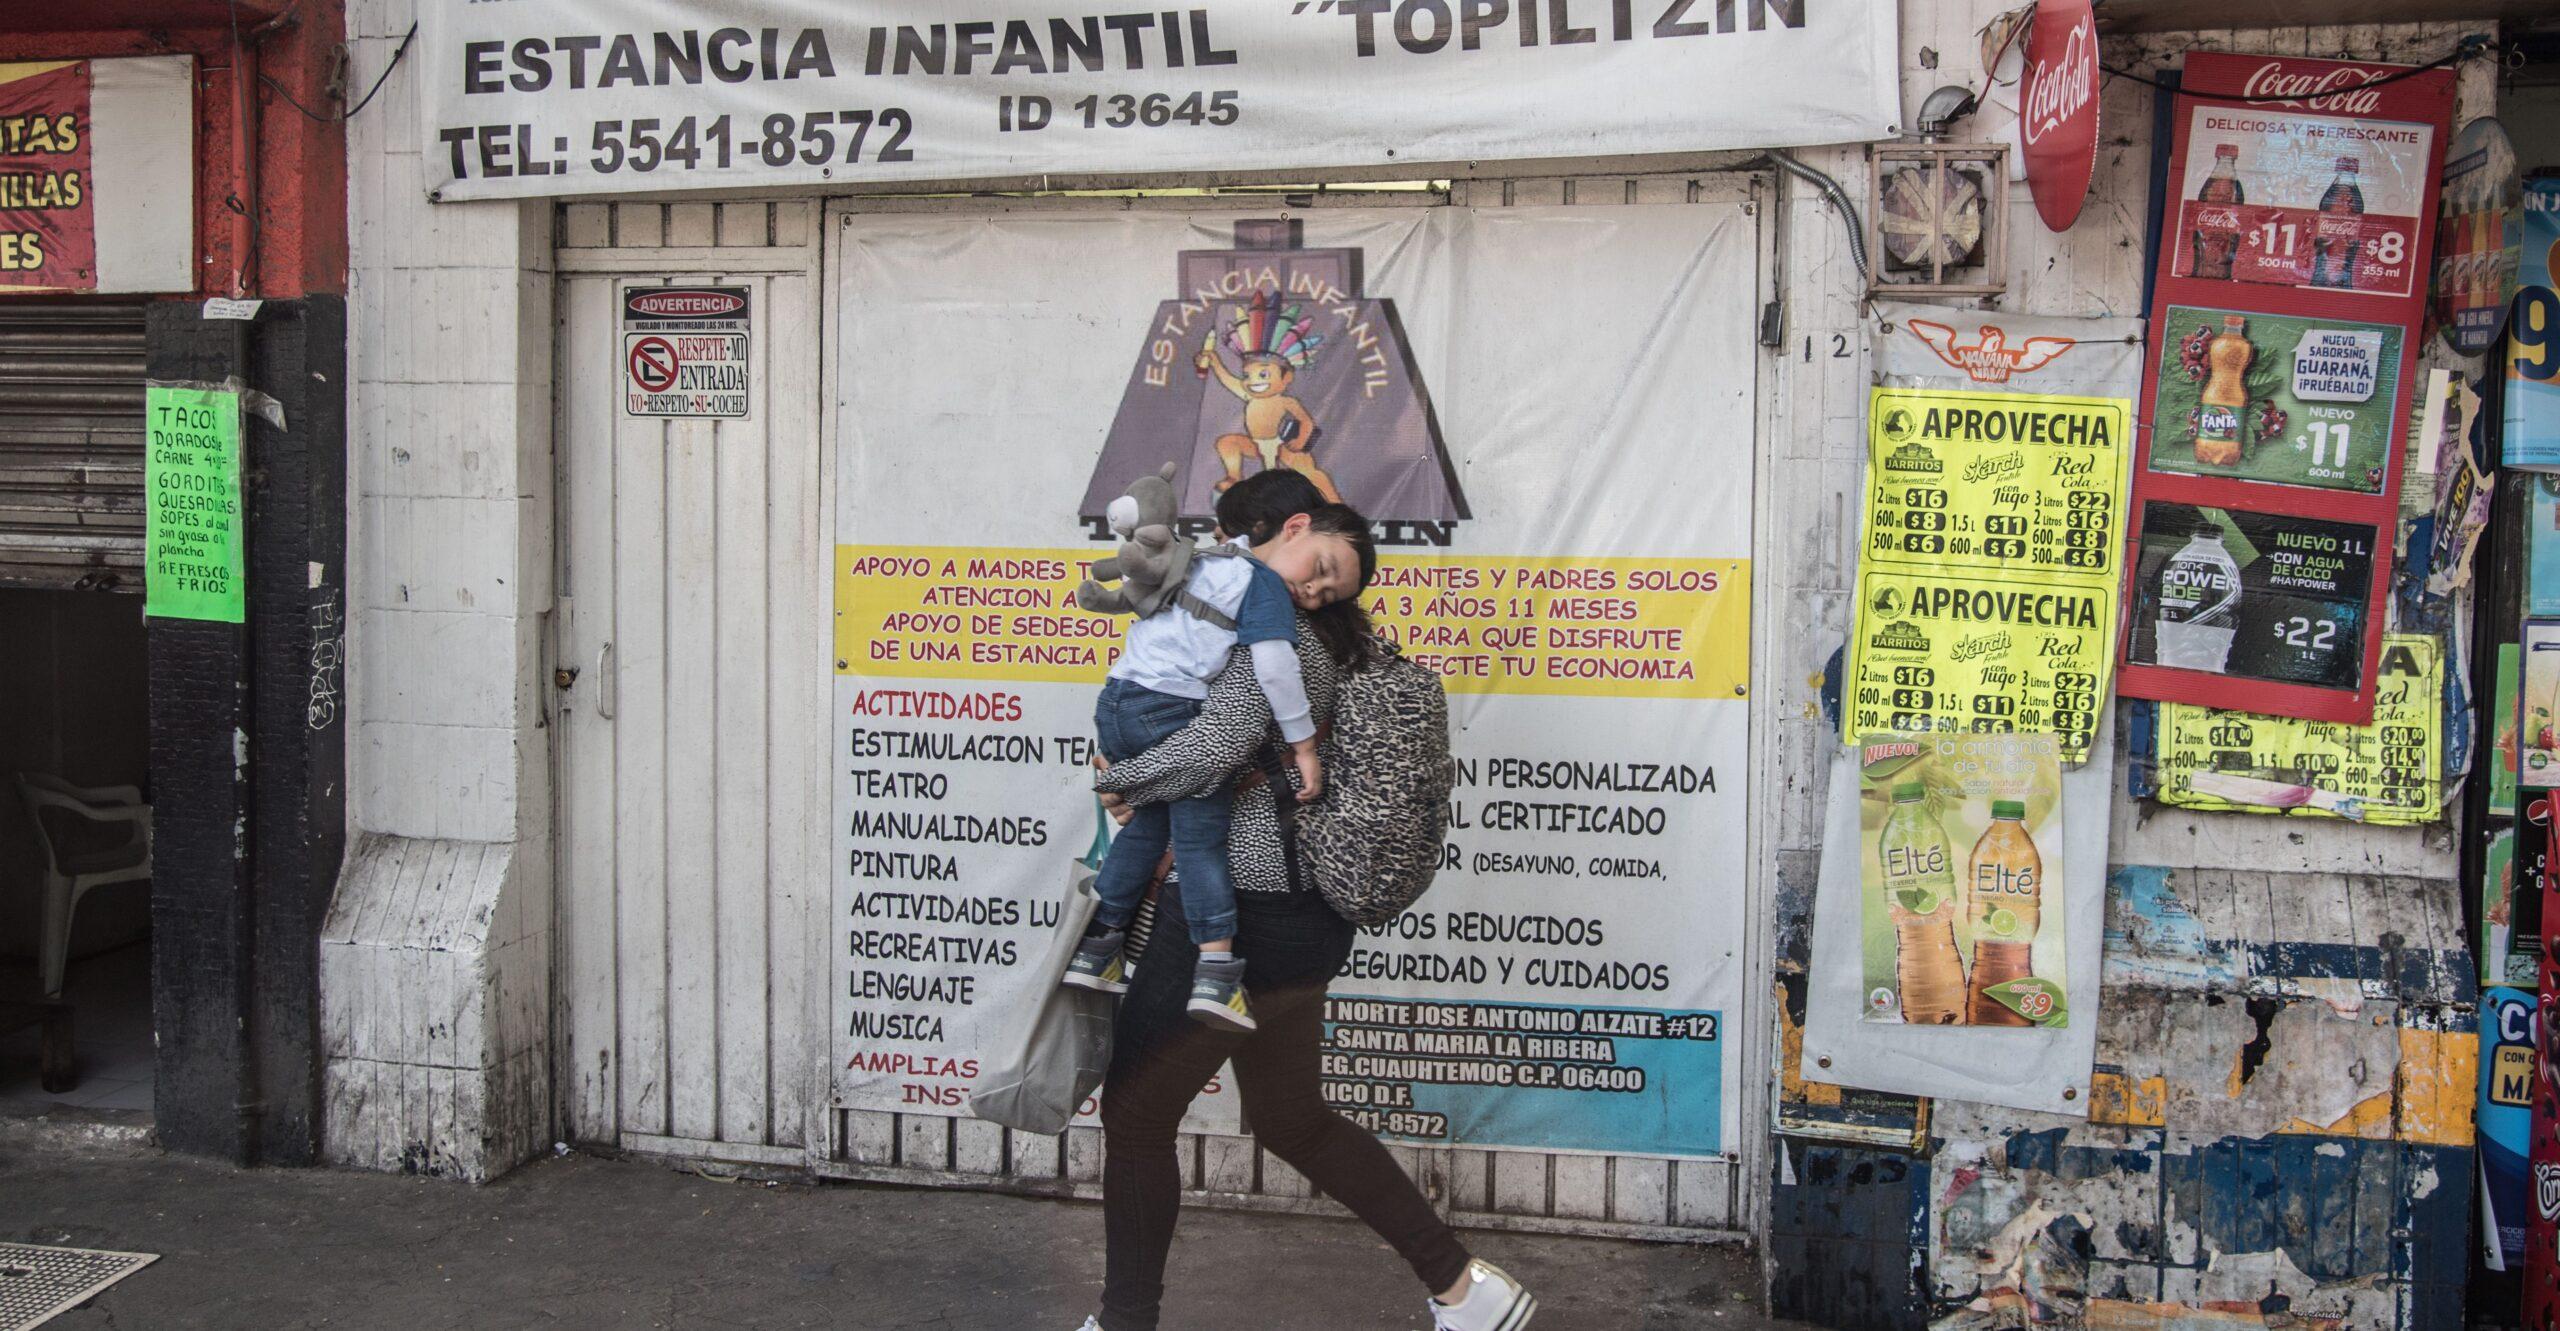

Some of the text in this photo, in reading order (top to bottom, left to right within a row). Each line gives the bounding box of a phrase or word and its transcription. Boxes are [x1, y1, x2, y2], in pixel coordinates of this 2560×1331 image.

[464, 9, 1238, 95] ESTANCIA INFANTIL
[2025, 14, 2091, 145] Coca-Cola
[2243, 62, 2391, 114] Coca-Cola
[1000, 90, 1240, 132] ID 13645
[0, 115, 78, 152] TAS
[2206, 117, 2419, 144] DELICIOSA REFRESCANTE
[440, 108, 913, 180] TEL: 5541-8572
[2248, 221, 2297, 257] $11
[2366, 231, 2405, 265] $8
[2257, 256, 2280, 269] 500
[640, 298, 734, 312] ADVERTENCIA
[636, 322, 660, 330] VIGILADO
[666, 321, 705, 330] MONITOREADO
[706, 321, 716, 330] LAS
[717, 321, 724, 330] 24
[1144, 266, 1389, 398] ESTANCIA INFANTIL
[2322, 334, 2356, 347] NUEVO
[680, 365, 745, 390] ENTRADA
[712, 394, 745, 413] COCHE
[2308, 406, 2355, 420] NUEVO
[158, 407, 216, 430] TACOS
[1921, 407, 2111, 446] APROVECHA
[2201, 414, 2238, 428] FANTA
[2295, 421, 2351, 468] $11
[155, 449, 194, 466] CARNE
[1886, 459, 1941, 472] JARRITOS
[2051, 453, 2095, 476] Red
[2061, 475, 2090, 489] Cola
[2308, 468, 2330, 479] 600
[1908, 490, 1943, 508] $16
[1992, 488, 2030, 511] Jugo
[2002, 484, 2019, 493] con
[2071, 492, 2106, 510] $22
[160, 510, 199, 526] SOPES
[1876, 510, 1937, 531] 600 $8
[1952, 514, 2023, 535] 1.5 $11
[2069, 511, 2104, 529] $16
[2438, 505, 2458, 551] VIVE
[159, 529, 175, 539] sin
[178, 530, 209, 545] grasa
[1873, 532, 1936, 553] 500 $6
[1950, 537, 2018, 557] 600 $6
[2032, 528, 2098, 548] 600 $8
[2276, 532, 2338, 552] NUEVO
[159, 543, 204, 558] plancha
[2032, 547, 2097, 567] 500 $6
[2273, 551, 2345, 571] CON AGUA
[159, 561, 230, 580] REFRESCOS
[853, 557, 931, 577] APOYO
[941, 559, 957, 578] A
[967, 560, 1066, 580] MADRES
[1490, 568, 1507, 589] Y
[1517, 568, 1616, 590] PADRES
[1627, 571, 1718, 591] SOLOS
[2163, 570, 2238, 591] POWER
[2272, 563, 2332, 581] DE COCO
[177, 577, 227, 594] FRIOS
[2270, 576, 2337, 592] #HAYPOWER
[922, 586, 1638, 620] ATENCION A A 3 AÑOS 11 MESES
[1910, 586, 2098, 628] APROVECHA
[883, 613, 961, 633] APOYO
[971, 614, 1002, 635] DE
[1012, 617, 1122, 639] SEDESOL
[1408, 625, 1470, 646] PARA
[1482, 626, 1537, 651] QUE
[1549, 628, 1682, 651] DISFRUTE
[2273, 616, 2337, 650] $22
[1872, 638, 1929, 650] JARRITOS
[2036, 635, 2083, 656] Red
[870, 640, 900, 660] DE
[910, 641, 961, 661] UNA
[972, 643, 1097, 665] ESTANCIA
[1500, 656, 1535, 677] TU
[1547, 656, 1695, 680] ECONOMIA
[2047, 656, 2077, 669] Cola
[1896, 667, 1930, 687] $16
[2057, 673, 2093, 692] $22
[852, 690, 1022, 722] ACTIVIDADES
[1899, 690, 1924, 709] $8
[2055, 692, 2091, 711] $16
[851, 728, 1043, 764] ESTIMULACION
[1863, 742, 1919, 767] NUEVO!
[851, 769, 948, 800] TEATRO
[1488, 758, 1716, 793] PERSONALIZADA
[851, 810, 1047, 846] MANUALIDADES
[1481, 801, 1666, 835] CERTIFICADO
[850, 849, 958, 882] PINTURA
[1473, 852, 1580, 878] (DESAYUNO,
[1589, 858, 1667, 881] COMIDA,
[1887, 845, 1944, 877] Elté
[1978, 863, 2034, 895] Elté
[851, 891, 1020, 926] ACTIVIDADES
[1448, 912, 1604, 946] REDUCIDOS
[850, 930, 1017, 966] RECREATIVAS
[1497, 956, 1670, 991] Y CUIDADOS
[849, 970, 974, 1005] LENGUAJE
[2020, 993, 2053, 1016] $9
[849, 1010, 943, 1042] MUSICA
[1338, 1001, 1713, 1038] NORTE JOSE ANTONIO ALZATE #12
[1336, 1028, 1613, 1061] SANTA MARIA LA RIBERA
[848, 1052, 979, 1079] AMPLIAS
[1518, 1066, 1642, 1090] C.P. 06400
[1374, 1085, 1411, 1106] D.F.
